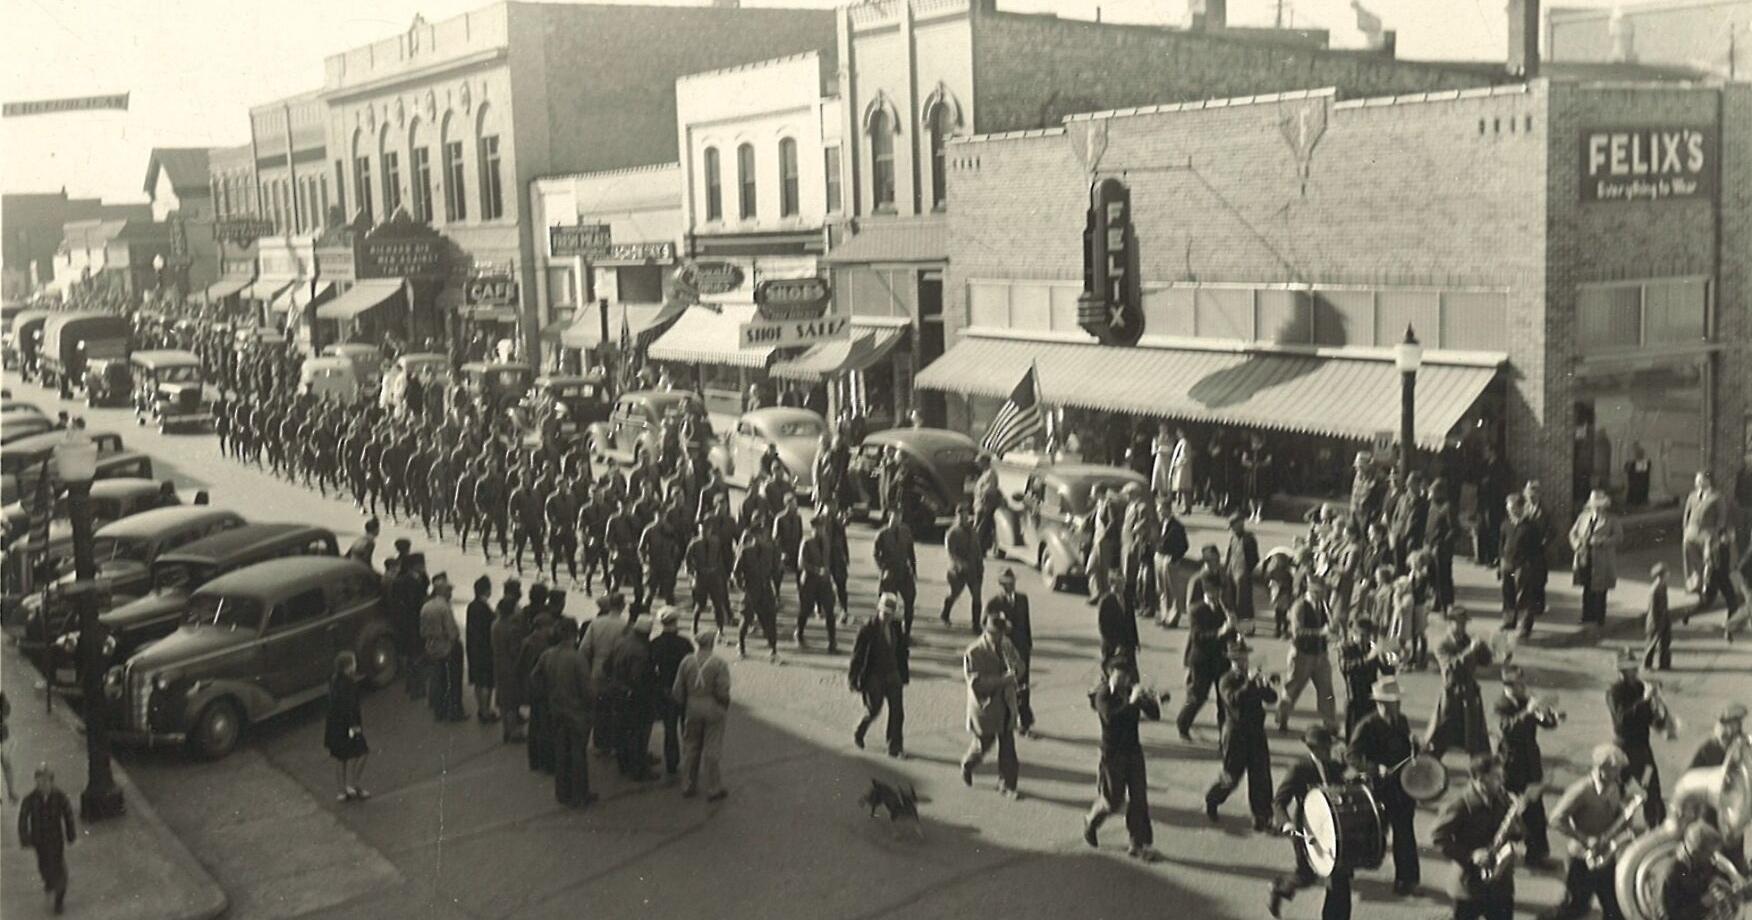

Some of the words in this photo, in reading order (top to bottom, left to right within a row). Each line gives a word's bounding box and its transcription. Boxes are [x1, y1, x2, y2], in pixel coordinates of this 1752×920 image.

[1589, 129, 1704, 176] FELIX'S
[1107, 201, 1125, 328] FELIX
[471, 282, 515, 302] CAFE
[766, 284, 825, 301] SHOES
[746, 326, 782, 343] SHOE
